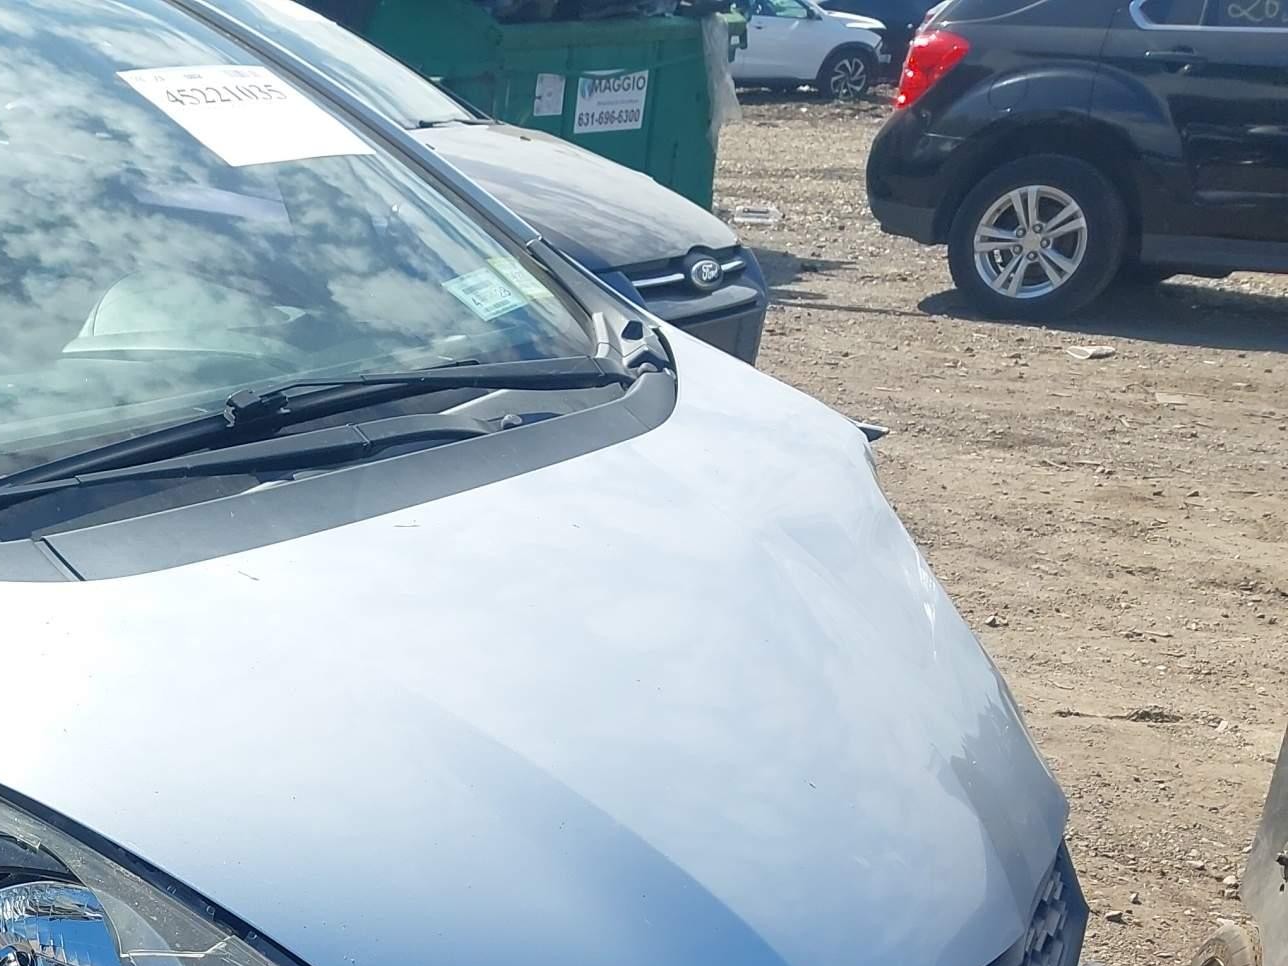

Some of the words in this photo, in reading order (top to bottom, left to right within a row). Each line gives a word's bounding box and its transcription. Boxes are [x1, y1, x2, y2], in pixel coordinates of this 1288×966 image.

[592, 75, 647, 94] MAGGIO
[165, 84, 289, 106] 45221035
[577, 108, 641, 127] 631-696-6300
